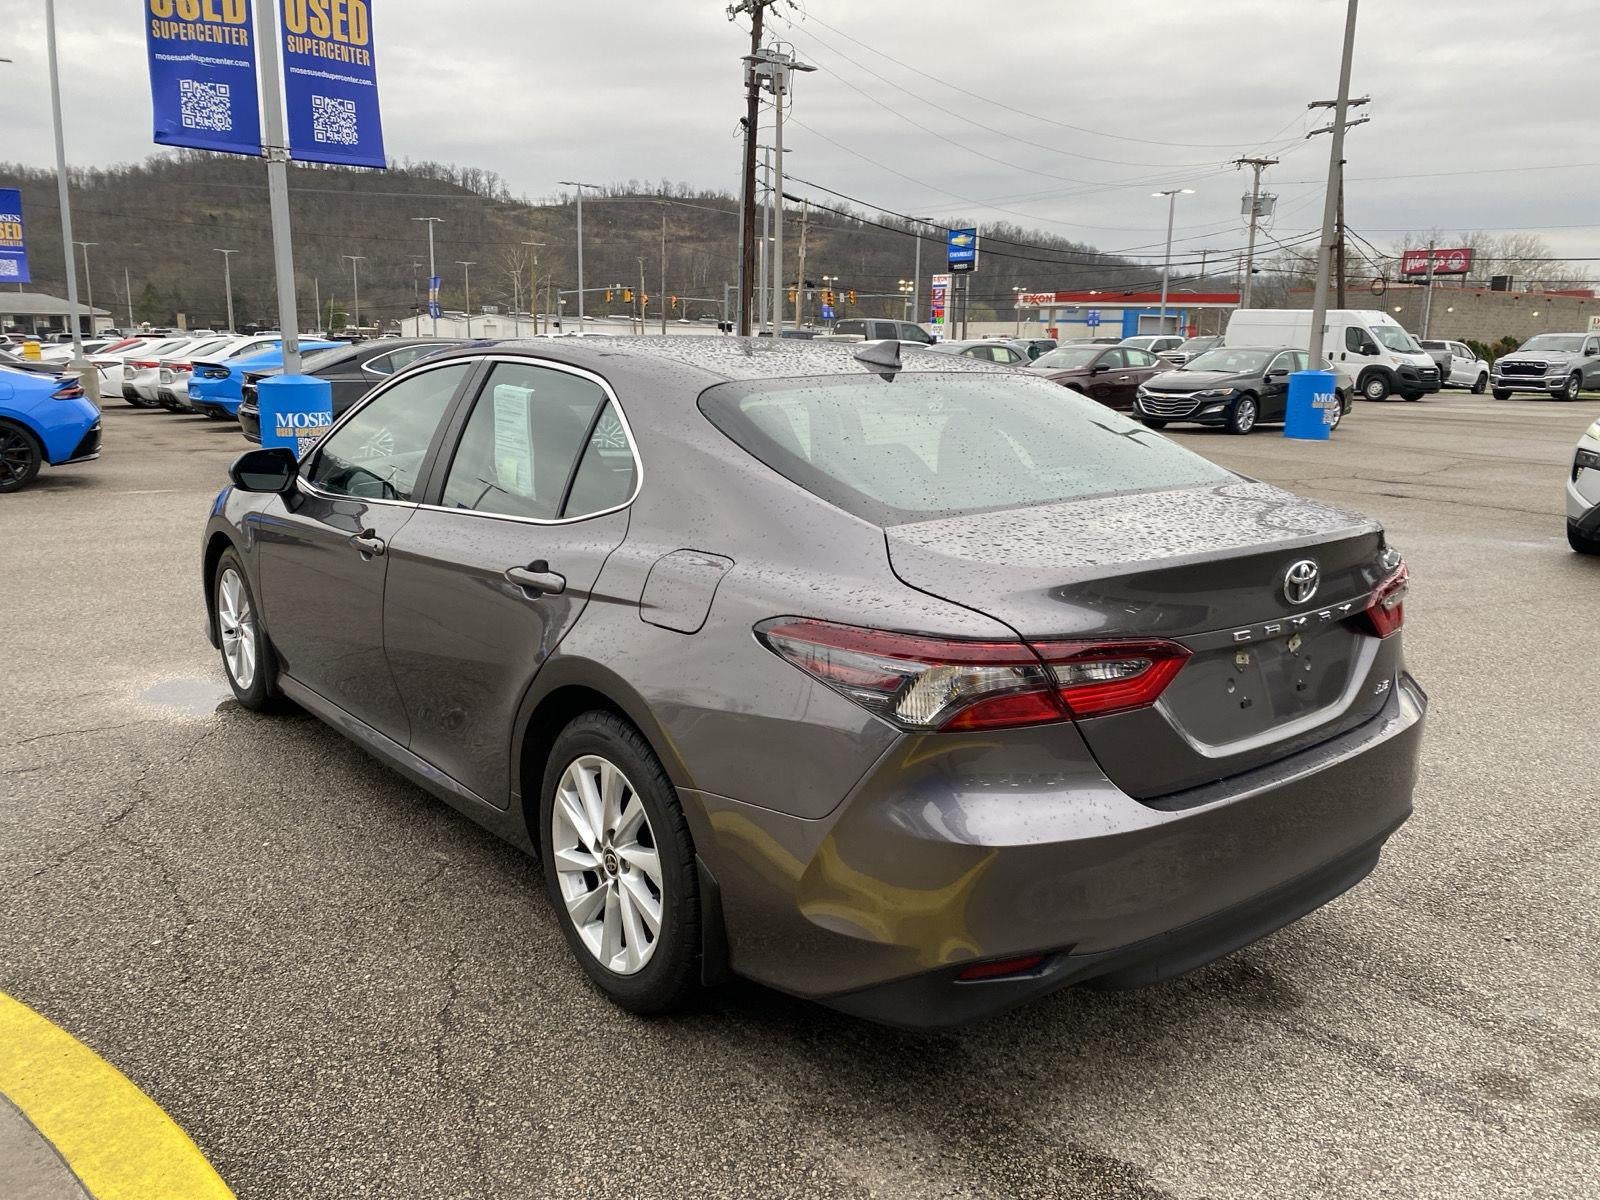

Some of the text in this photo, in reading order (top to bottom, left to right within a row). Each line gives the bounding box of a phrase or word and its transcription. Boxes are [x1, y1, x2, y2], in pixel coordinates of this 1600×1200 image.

[151, 19, 249, 47] SUPERCENTER
[284, 0, 369, 46] USED
[155, 53, 250, 68] mosesusedsupercenter.com
[286, 34, 371, 67] SUPERCENTER
[1023, 294, 1053, 305] EXXON
[275, 411, 332, 428] MOSES
[1232, 603, 1353, 642] CAMRY
